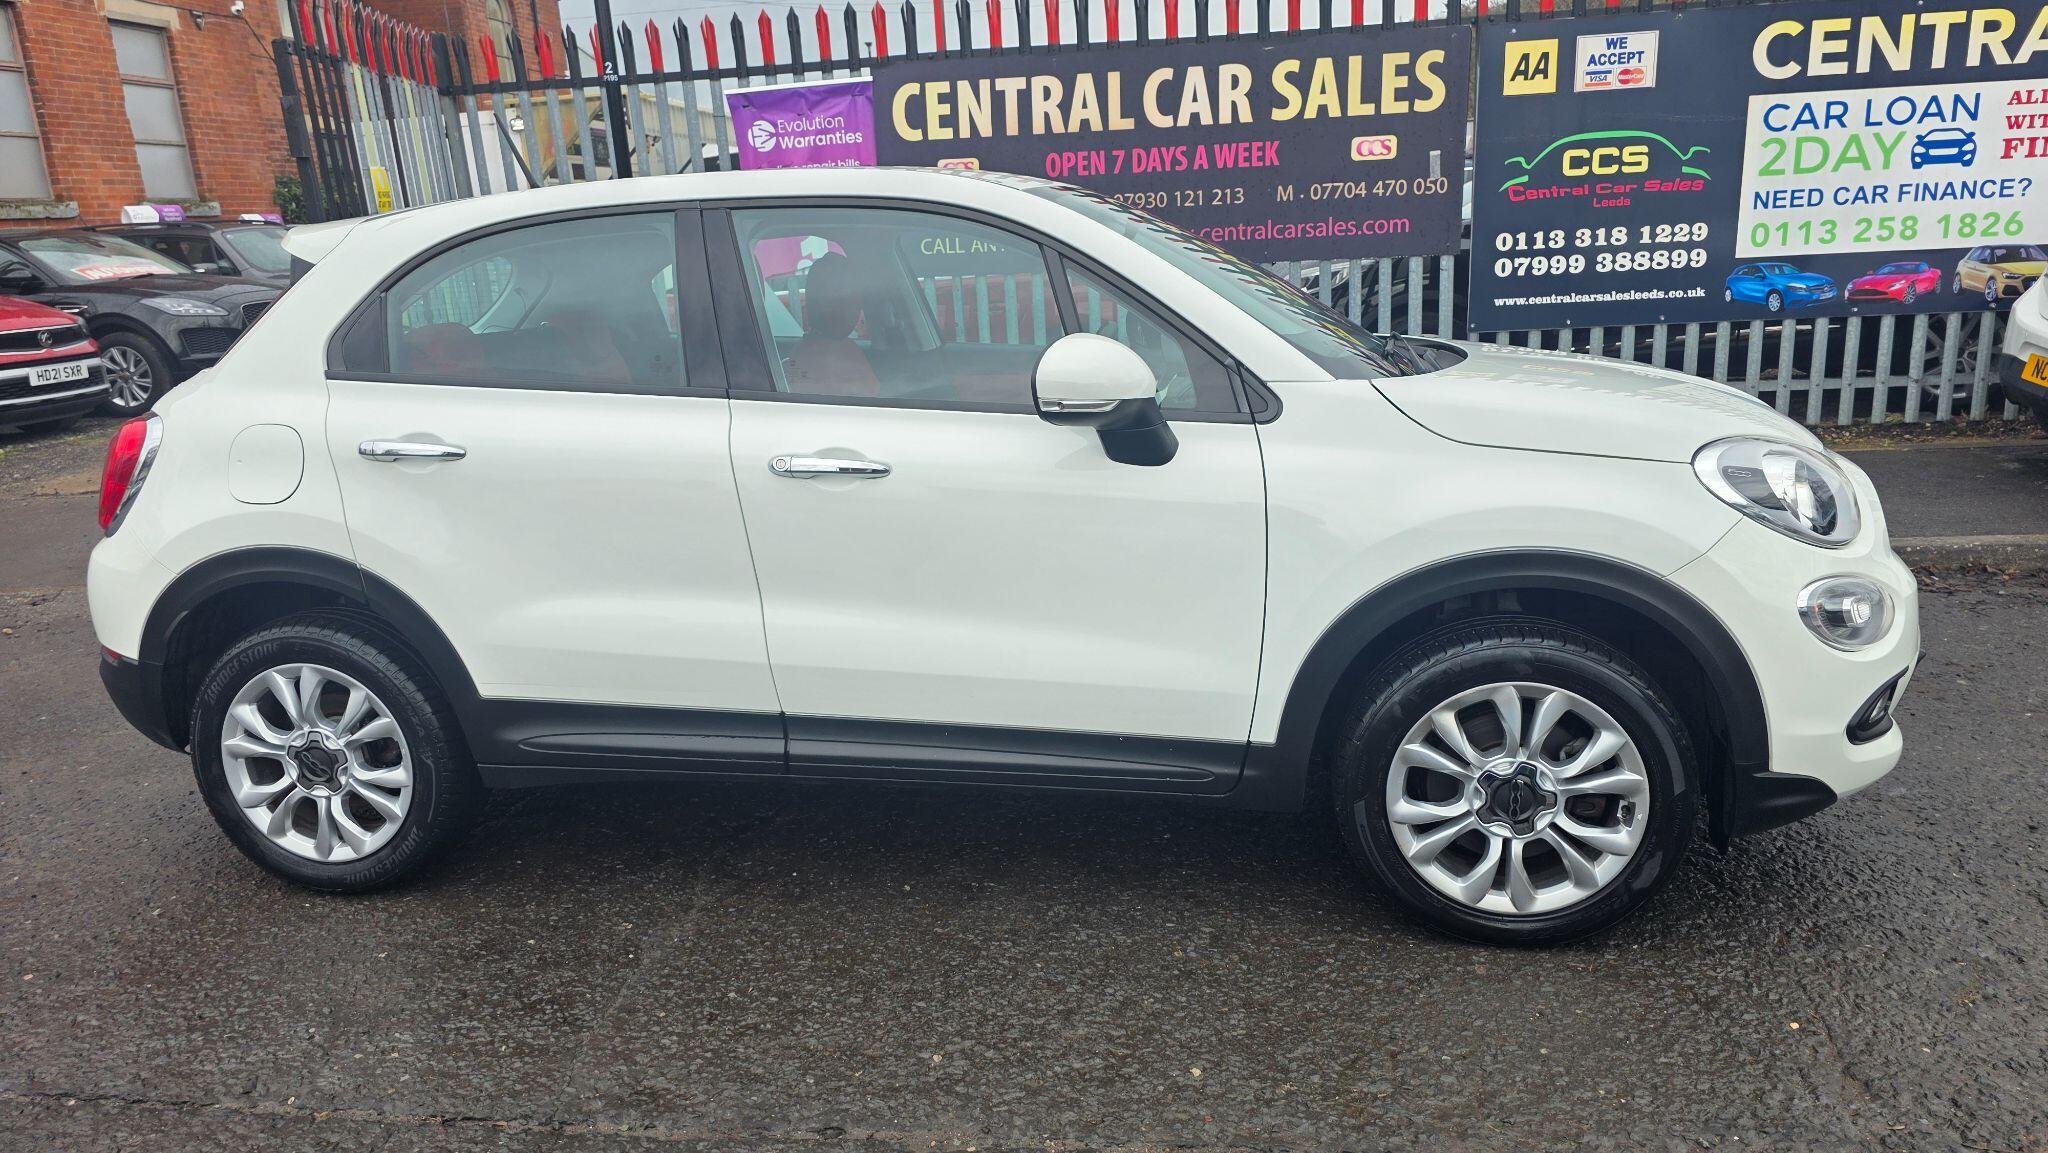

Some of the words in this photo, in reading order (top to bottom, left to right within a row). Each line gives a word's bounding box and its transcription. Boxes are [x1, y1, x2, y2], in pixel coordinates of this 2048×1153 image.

[1605, 36, 1628, 51] WE
[604, 61, 614, 74] 2
[1510, 51, 1550, 82] AA
[1586, 50, 1645, 67] ACCEPT
[1589, 74, 1608, 83] VISA
[892, 71, 1135, 142] CENTRAL
[1143, 63, 1253, 128] CAR
[1271, 49, 1446, 121] SALES
[1763, 100, 1849, 132] CAR
[1864, 92, 1981, 127] LOAN
[777, 115, 845, 133] Evolution
[779, 130, 863, 150] Warranties
[1356, 139, 1392, 156] CCS
[1046, 151, 1105, 178] OPEN
[1112, 150, 1126, 173] 7
[1133, 145, 1187, 172] DAYS
[1193, 144, 1209, 170] A
[1214, 140, 1280, 169] WEEK
[1562, 145, 1649, 177] CCS
[1758, 130, 1907, 176] 2DAY
[1174, 190, 1203, 207] 121
[1212, 188, 1245, 205] 213
[1310, 181, 1367, 200] 07704
[1373, 179, 1407, 197] 470
[1413, 177, 1448, 195] 050
[1508, 184, 1589, 201] Central
[1596, 182, 1637, 194] Car
[1643, 177, 1705, 192] Sales
[1753, 188, 1824, 210] NEED
[1833, 184, 1888, 206] CAR
[1897, 177, 2033, 203] FINANCE?
[1593, 197, 1631, 208] Leeds
[1495, 229, 1565, 251] 0113
[1574, 226, 1628, 247] 318
[1639, 222, 1709, 244] 1229
[1750, 219, 1838, 248] 0113
[1853, 215, 1919, 243] 258
[1937, 210, 2024, 239] 1826
[920, 237, 966, 255] CALL
[1494, 254, 1586, 278] 07999
[1595, 248, 1708, 273] 388899
[1494, 286, 1705, 306] www.centralcarsalesleeds.co.uk
[36, 367, 62, 383] HD21
[63, 364, 83, 379] SXR
